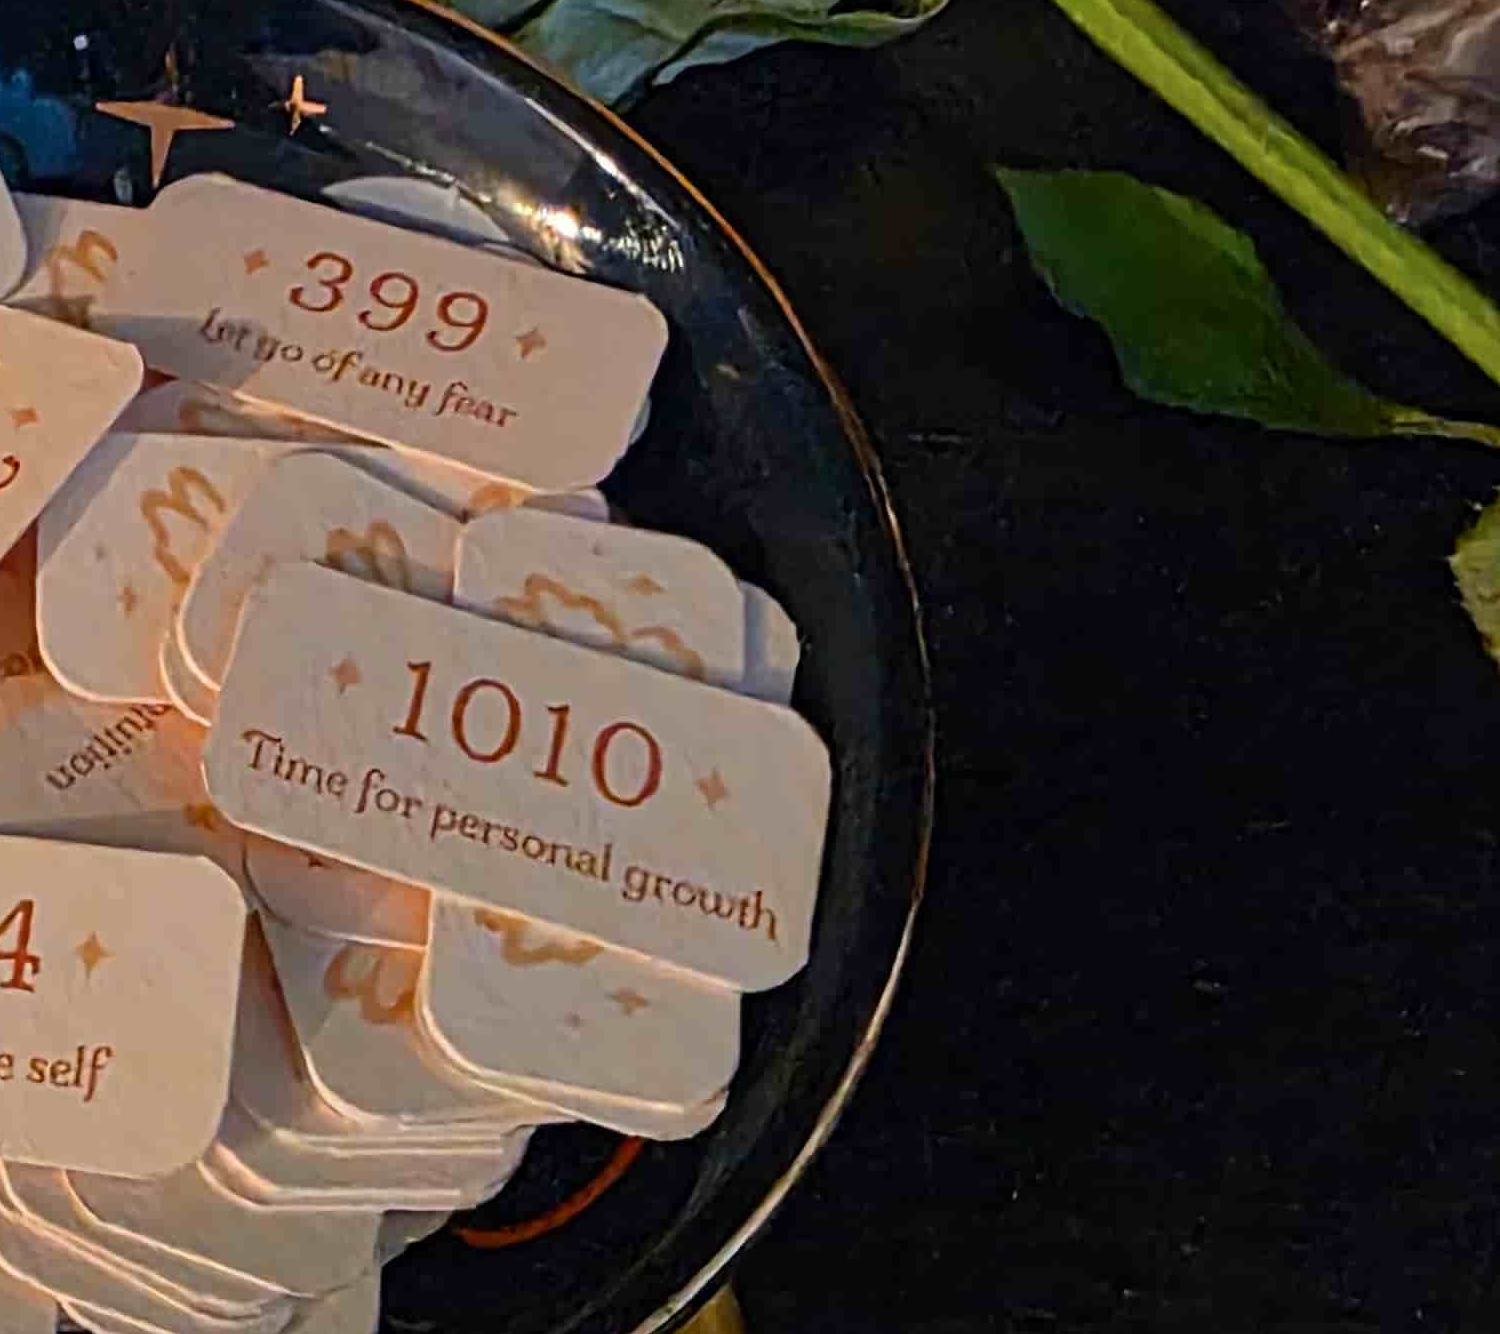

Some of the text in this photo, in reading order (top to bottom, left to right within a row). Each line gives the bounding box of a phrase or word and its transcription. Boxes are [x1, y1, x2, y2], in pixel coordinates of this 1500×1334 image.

[289, 251, 488, 352] 399
[200, 306, 517, 429] Let go of any fear
[391, 660, 664, 808] 1010
[240, 726, 782, 948] Time for personal growth
[26, 1042, 116, 1103] self
